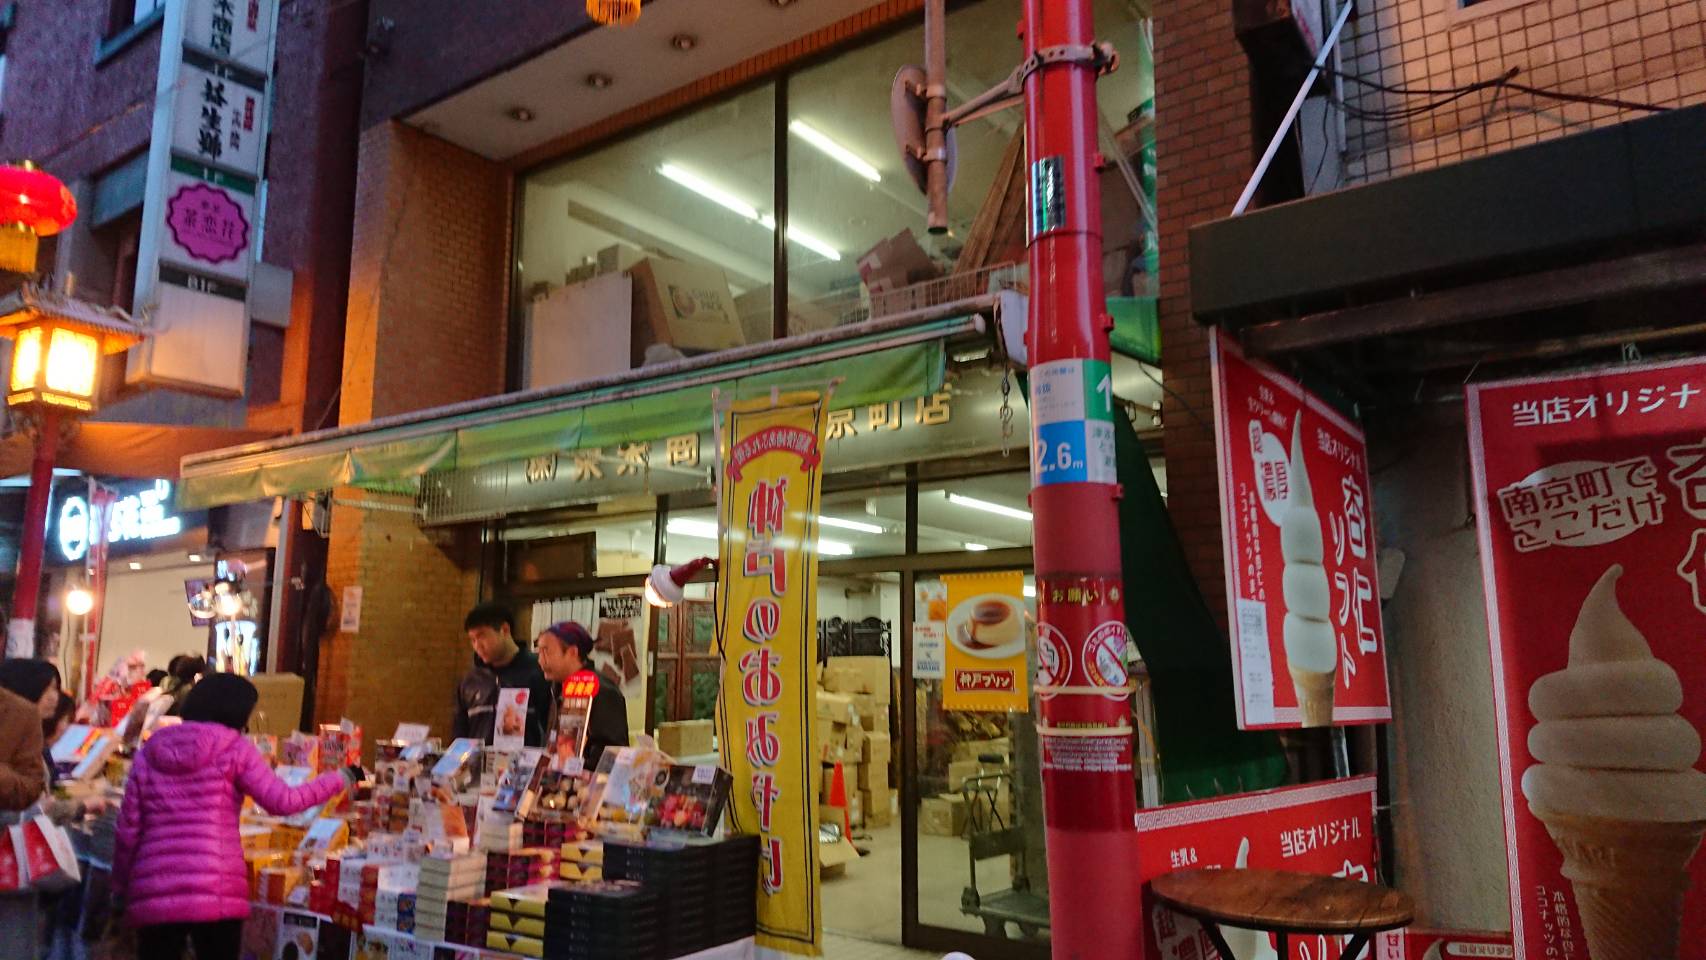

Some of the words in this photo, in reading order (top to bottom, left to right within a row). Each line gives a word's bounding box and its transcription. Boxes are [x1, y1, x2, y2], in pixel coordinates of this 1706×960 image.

[1511, 382, 1701, 428] 当店オリジナ
[1500, 460, 1656, 519] 南京町で
[1513, 494, 1663, 549] ここだけ
[1329, 511, 1357, 690] ソフト
[959, 672, 1011, 689] 神戸プリン
[1170, 847, 1199, 869] 生乳&
[1280, 817, 1362, 859] 当店オリジナル
[1535, 885, 1559, 960] ココナッツの
